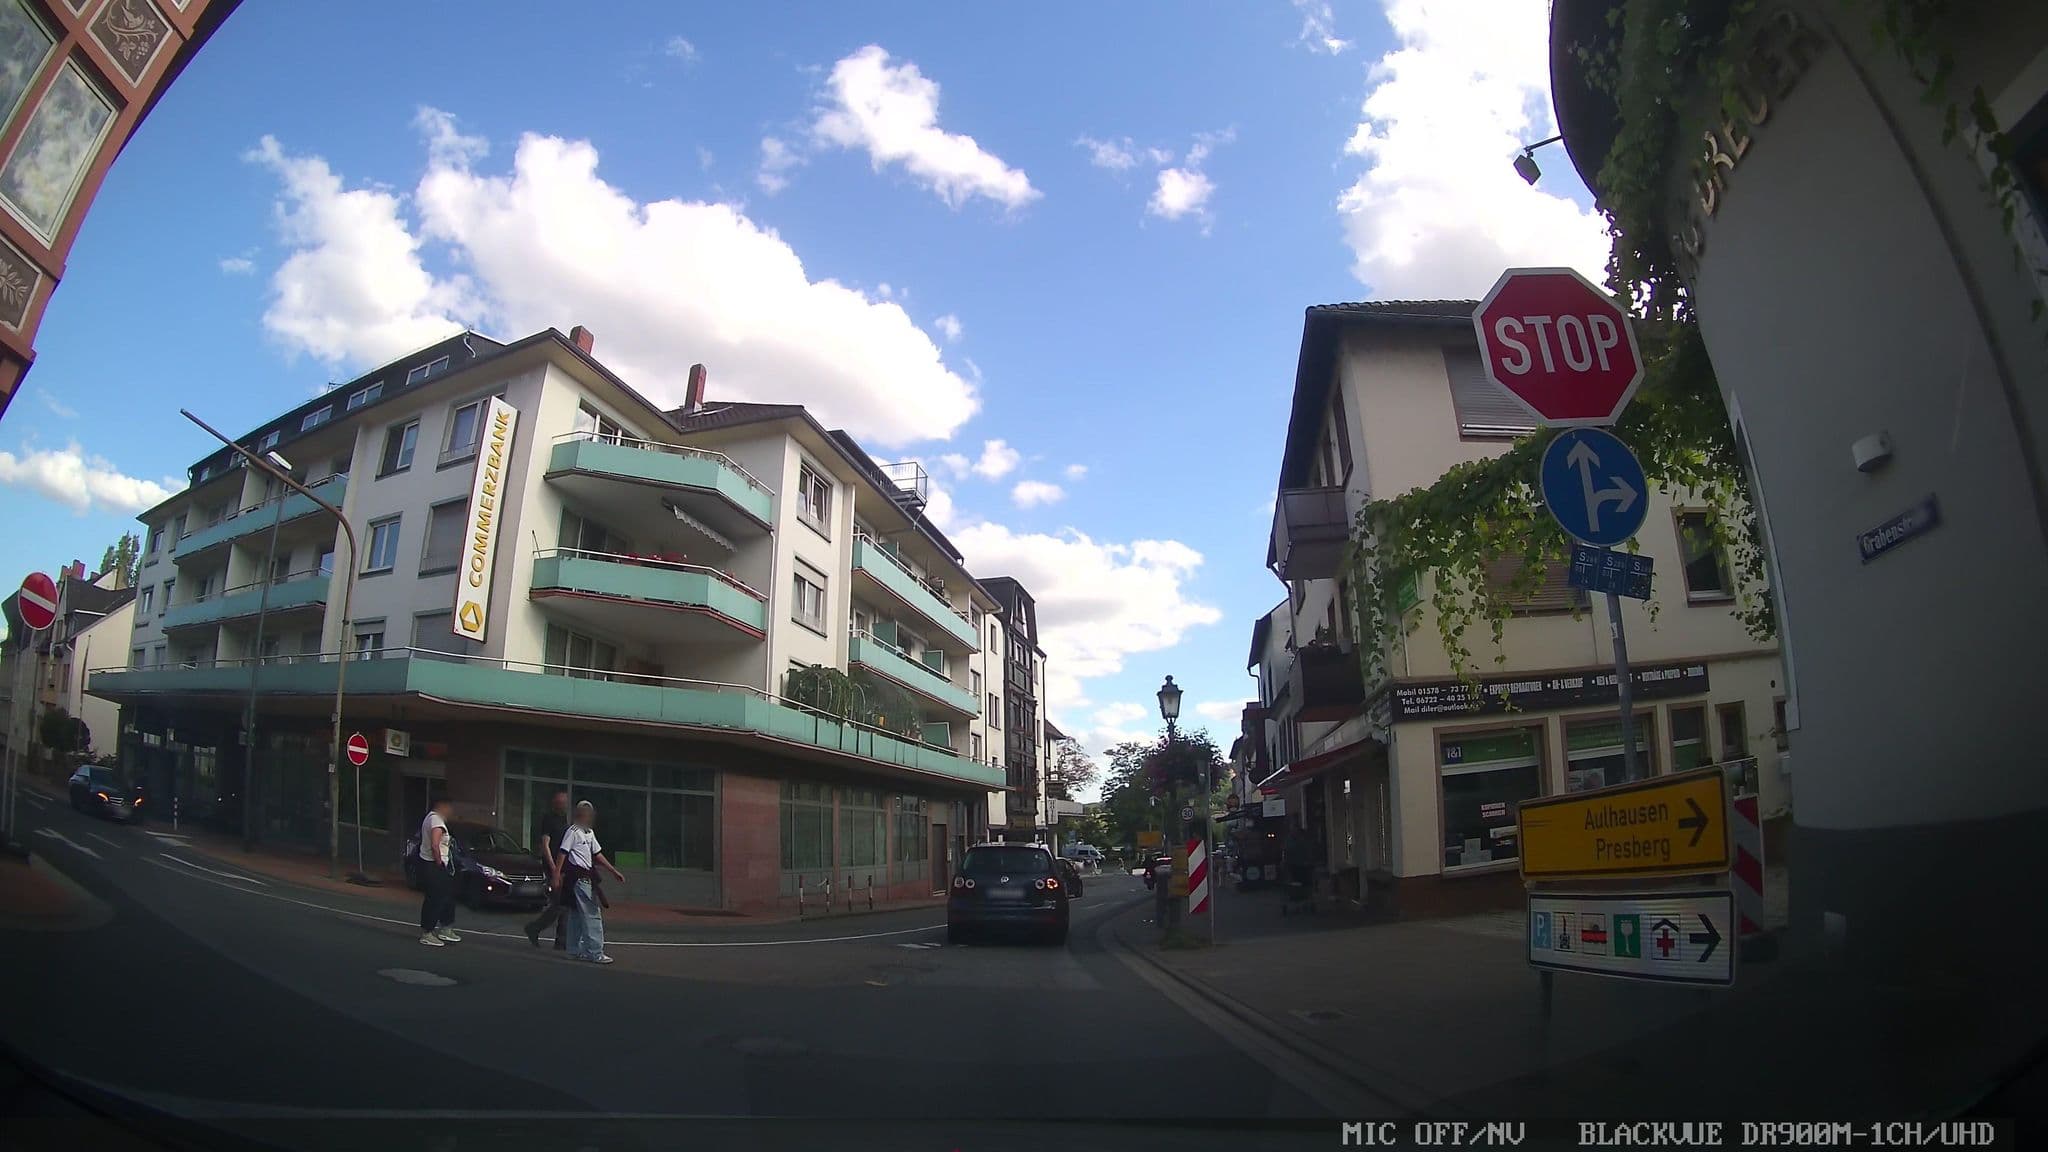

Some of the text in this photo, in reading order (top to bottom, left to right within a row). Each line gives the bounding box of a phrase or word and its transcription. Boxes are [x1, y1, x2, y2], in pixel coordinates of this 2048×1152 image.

[1495, 314, 1618, 375] STOP
[469, 410, 510, 588] COMMERZBANK
[1397, 688, 1416, 697] Mobil
[1417, 687, 1439, 696] 01578
[1401, 697, 1415, 705] Tel.
[1416, 695, 1438, 704] 06722
[1404, 706, 1420, 714] Mail
[1447, 746, 1462, 758] 1&1
[1584, 803, 1669, 830] Aulhausen
[1596, 835, 1670, 862] Presberg
